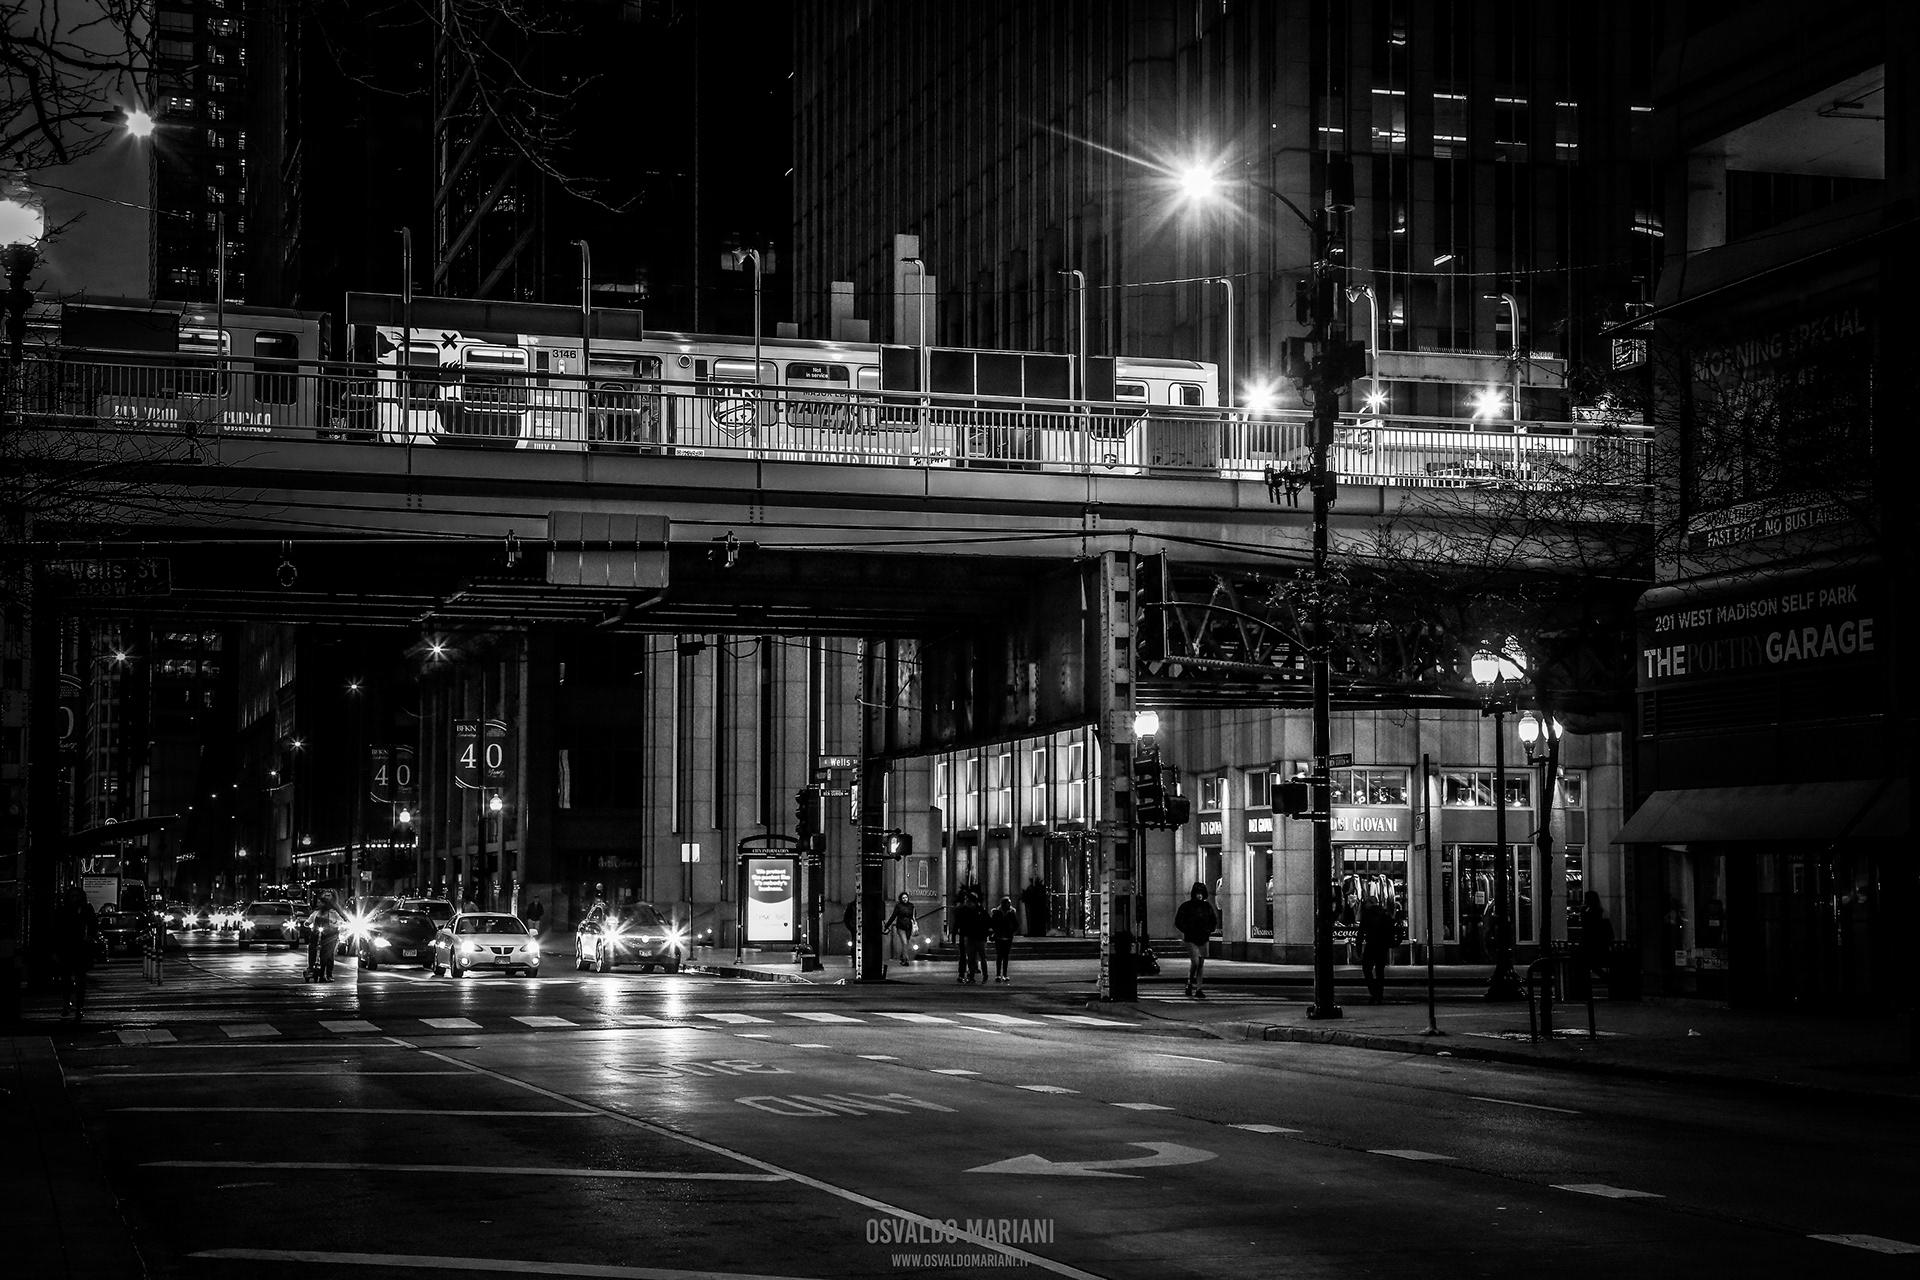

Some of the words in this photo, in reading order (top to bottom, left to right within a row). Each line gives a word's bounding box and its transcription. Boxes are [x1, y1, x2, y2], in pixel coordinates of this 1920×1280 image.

[552, 350, 577, 359] 3146
[143, 406, 178, 429] YOUR
[224, 411, 272, 434] CHICAGO
[812, 445, 860, 465] TICKETS
[864, 447, 901, 466] TODAY
[1707, 528, 1731, 548] FAST
[1734, 515, 1757, 542] EXIT
[1765, 517, 1783, 537] NO
[1785, 512, 1807, 533] BUS
[70, 562, 123, 580] Wells
[1655, 613, 1676, 633] 201
[1679, 607, 1713, 629] WEST
[1717, 597, 1778, 624] MADISON
[1782, 590, 1815, 614] SELF
[1819, 584, 1858, 608] PARK
[1643, 645, 1686, 679] THE
[1686, 632, 1765, 675] POETRY
[1766, 618, 1875, 664] GARAGE
[830, 758, 851, 767] Wells
[1353, 817, 1397, 833] GIOVANI
